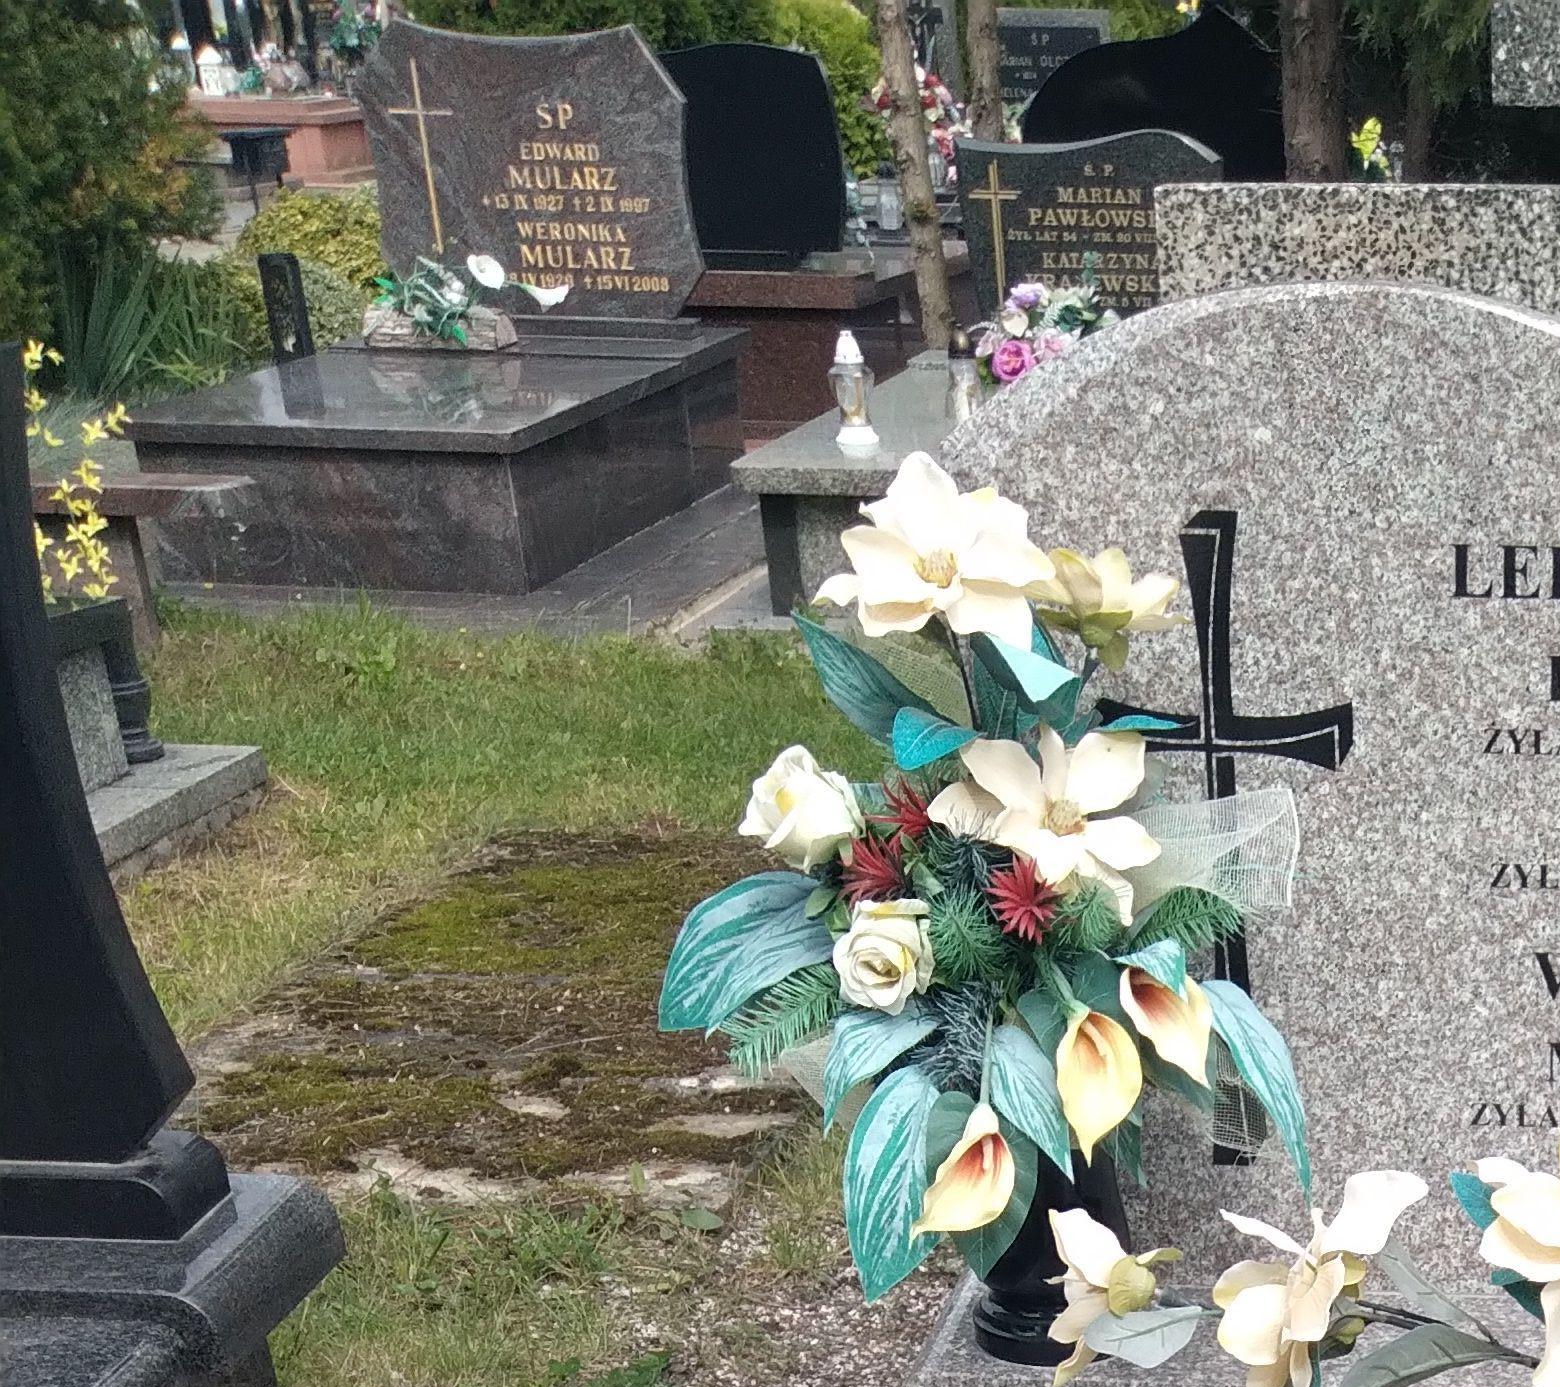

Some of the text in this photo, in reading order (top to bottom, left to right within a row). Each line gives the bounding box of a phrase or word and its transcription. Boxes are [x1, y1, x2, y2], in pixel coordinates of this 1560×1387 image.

[520, 142, 600, 161] EDWARD
[508, 165, 618, 191] MULARZ
[586, 196, 596, 212] 2
[1056, 187, 1142, 204] MARIAN
[1028, 208, 1156, 228] PAWŁOWS
[517, 222, 627, 243] WERONIKA
[519, 244, 635, 271] MULARZ
